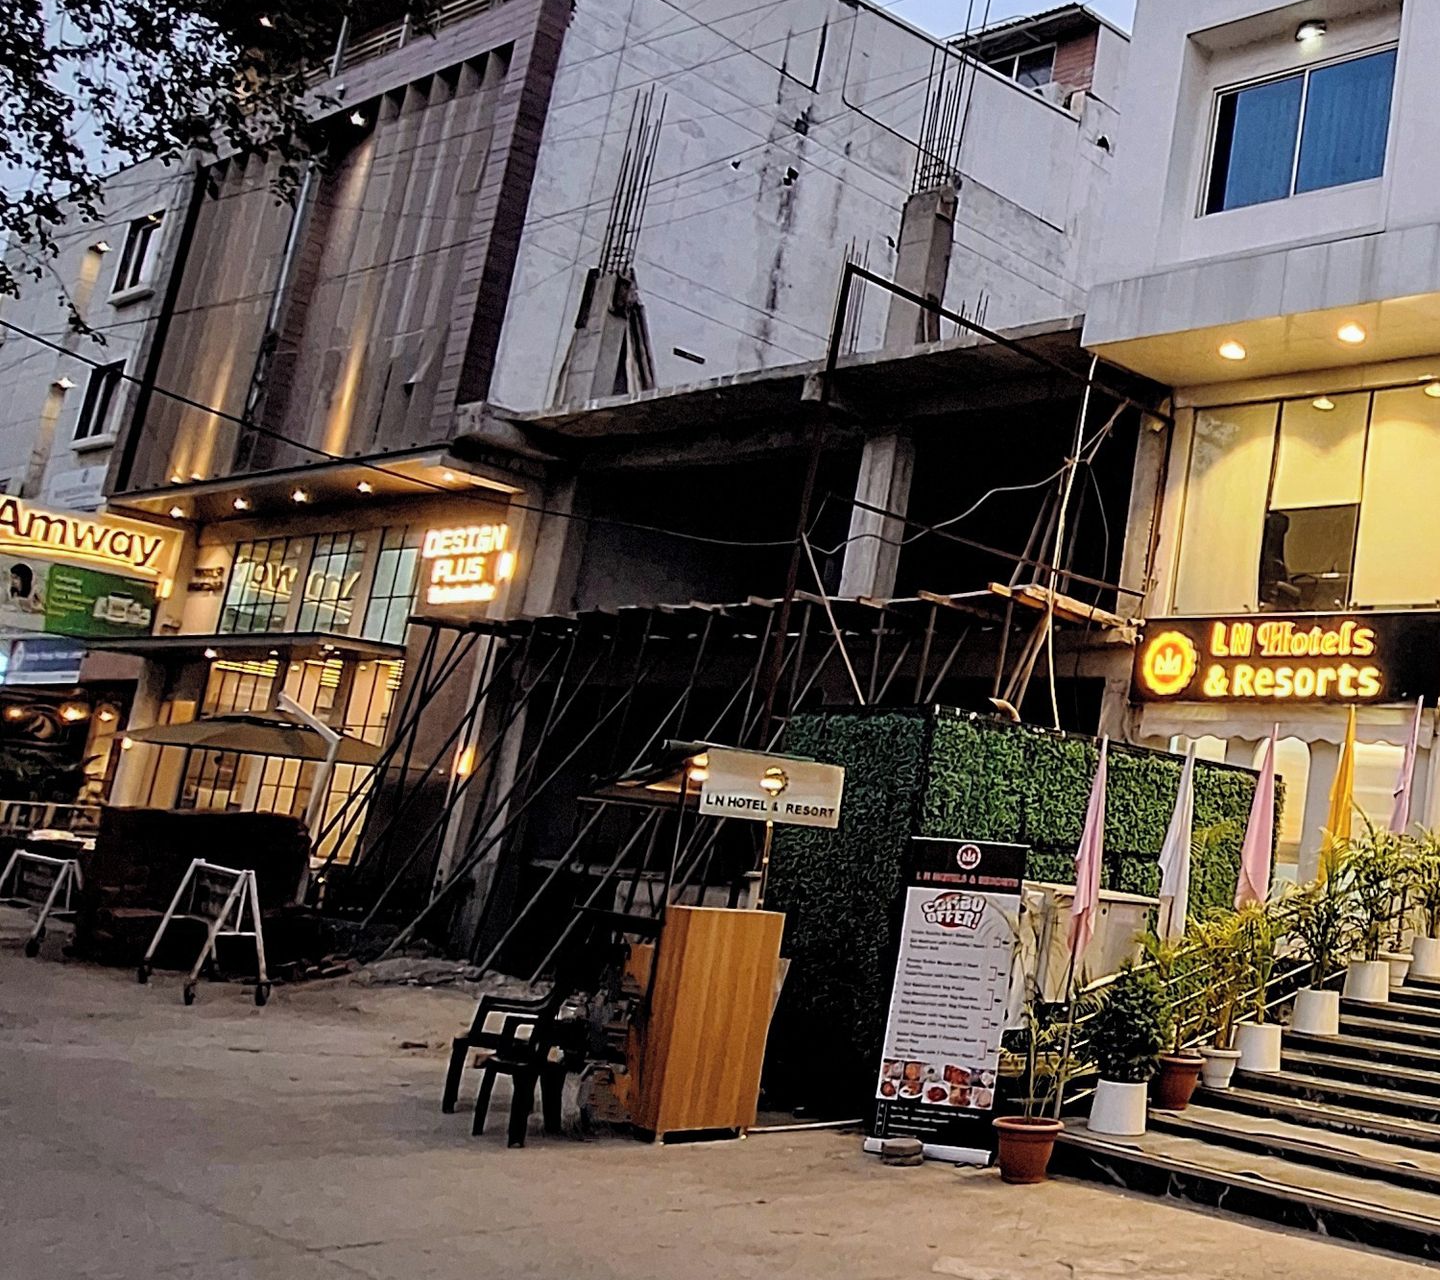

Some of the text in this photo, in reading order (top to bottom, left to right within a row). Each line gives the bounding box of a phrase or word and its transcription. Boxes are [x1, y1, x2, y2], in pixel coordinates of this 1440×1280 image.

[0, 499, 162, 566] Amway
[422, 524, 508, 559] DESIGN
[431, 556, 485, 584] PLUS
[1256, 621, 1376, 657] Hotels
[1203, 663, 1382, 697] & Resorts
[727, 797, 768, 812] HOTEL
[785, 803, 835, 818] RESORT
[922, 894, 986, 914] COMBO
[925, 910, 982, 929] OFFER!
